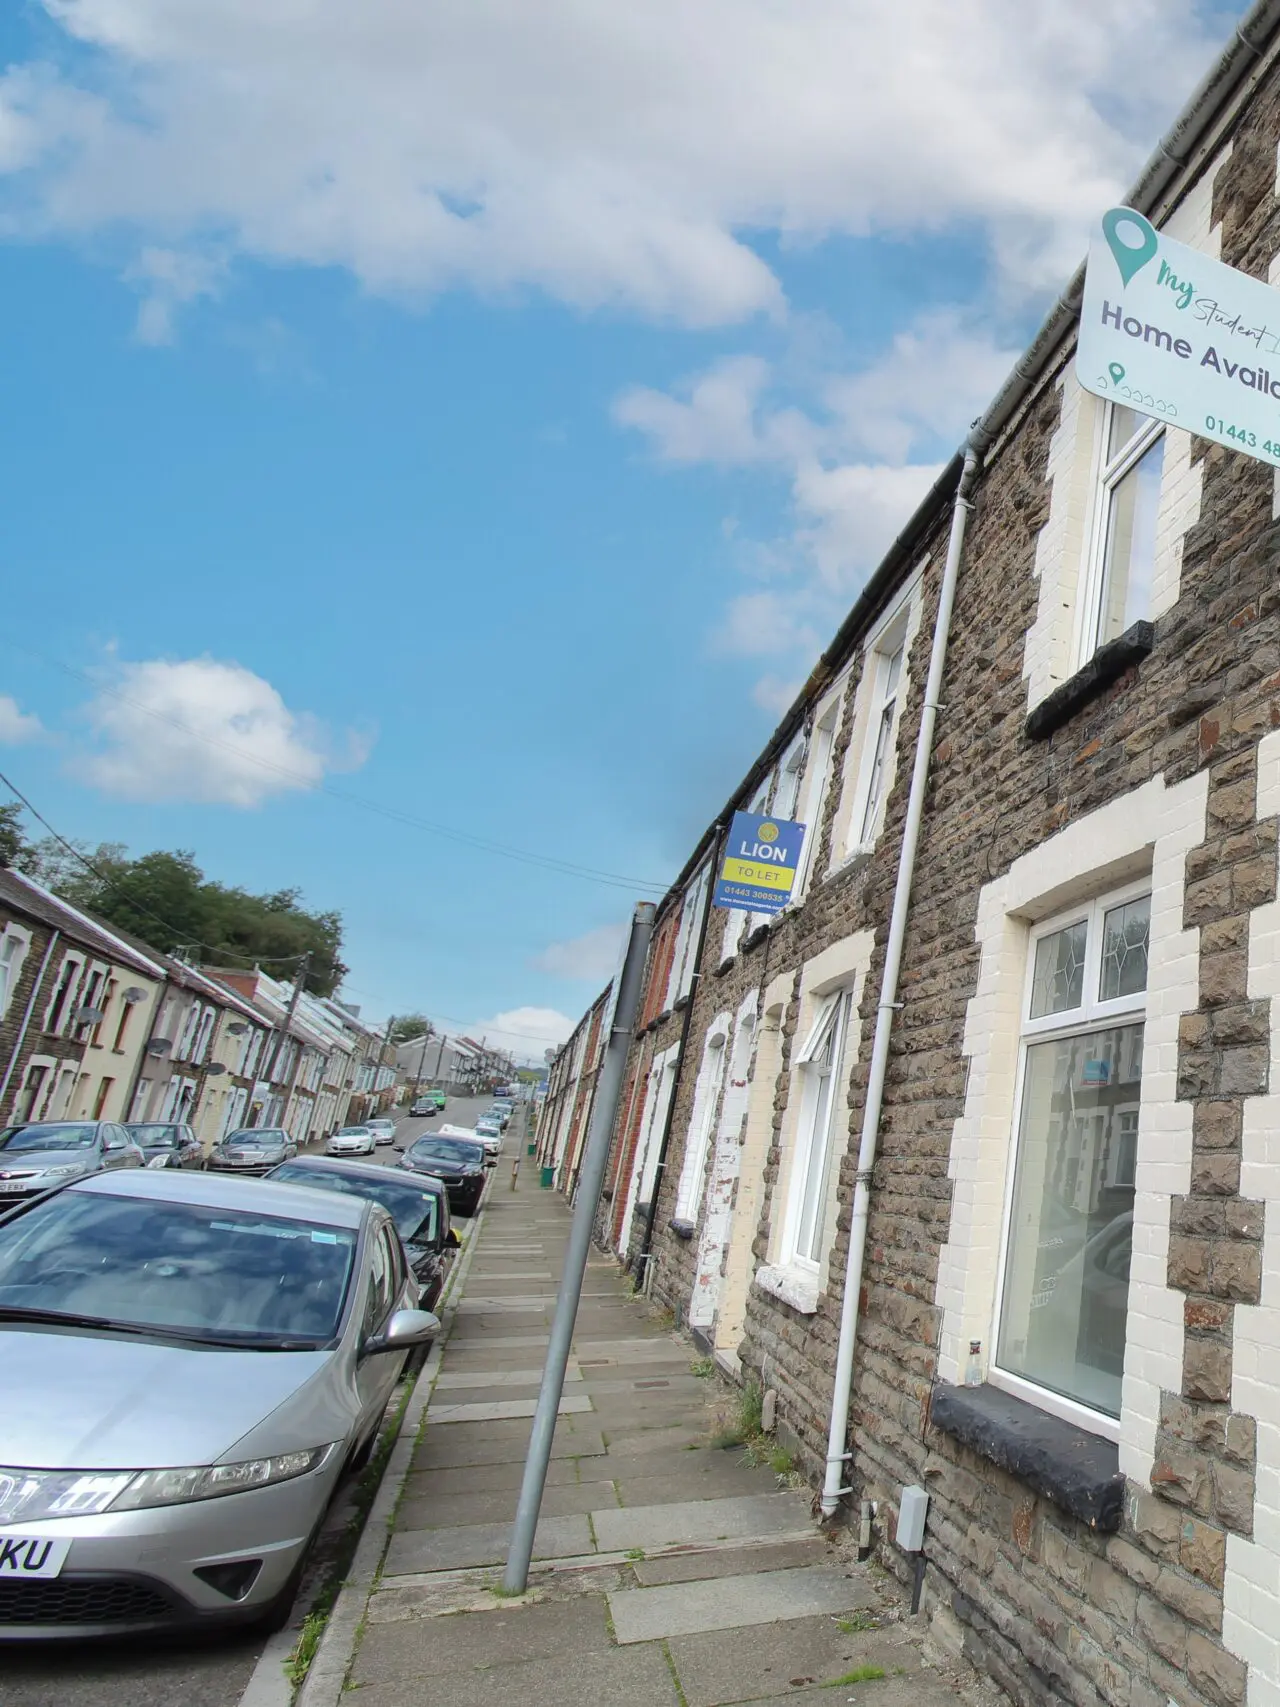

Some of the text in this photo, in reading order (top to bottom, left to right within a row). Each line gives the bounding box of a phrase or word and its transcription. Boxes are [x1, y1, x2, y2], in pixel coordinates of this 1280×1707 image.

[1157, 259, 1197, 310] My
[1193, 299, 1278, 348] Student
[1101, 300, 1192, 359] Home
[1205, 415, 1257, 448] 01443
[740, 841, 787, 862] LION
[738, 866, 780, 882] TO LET
[724, 886, 750, 897] 01443
[0, 1538, 54, 1571] KU
